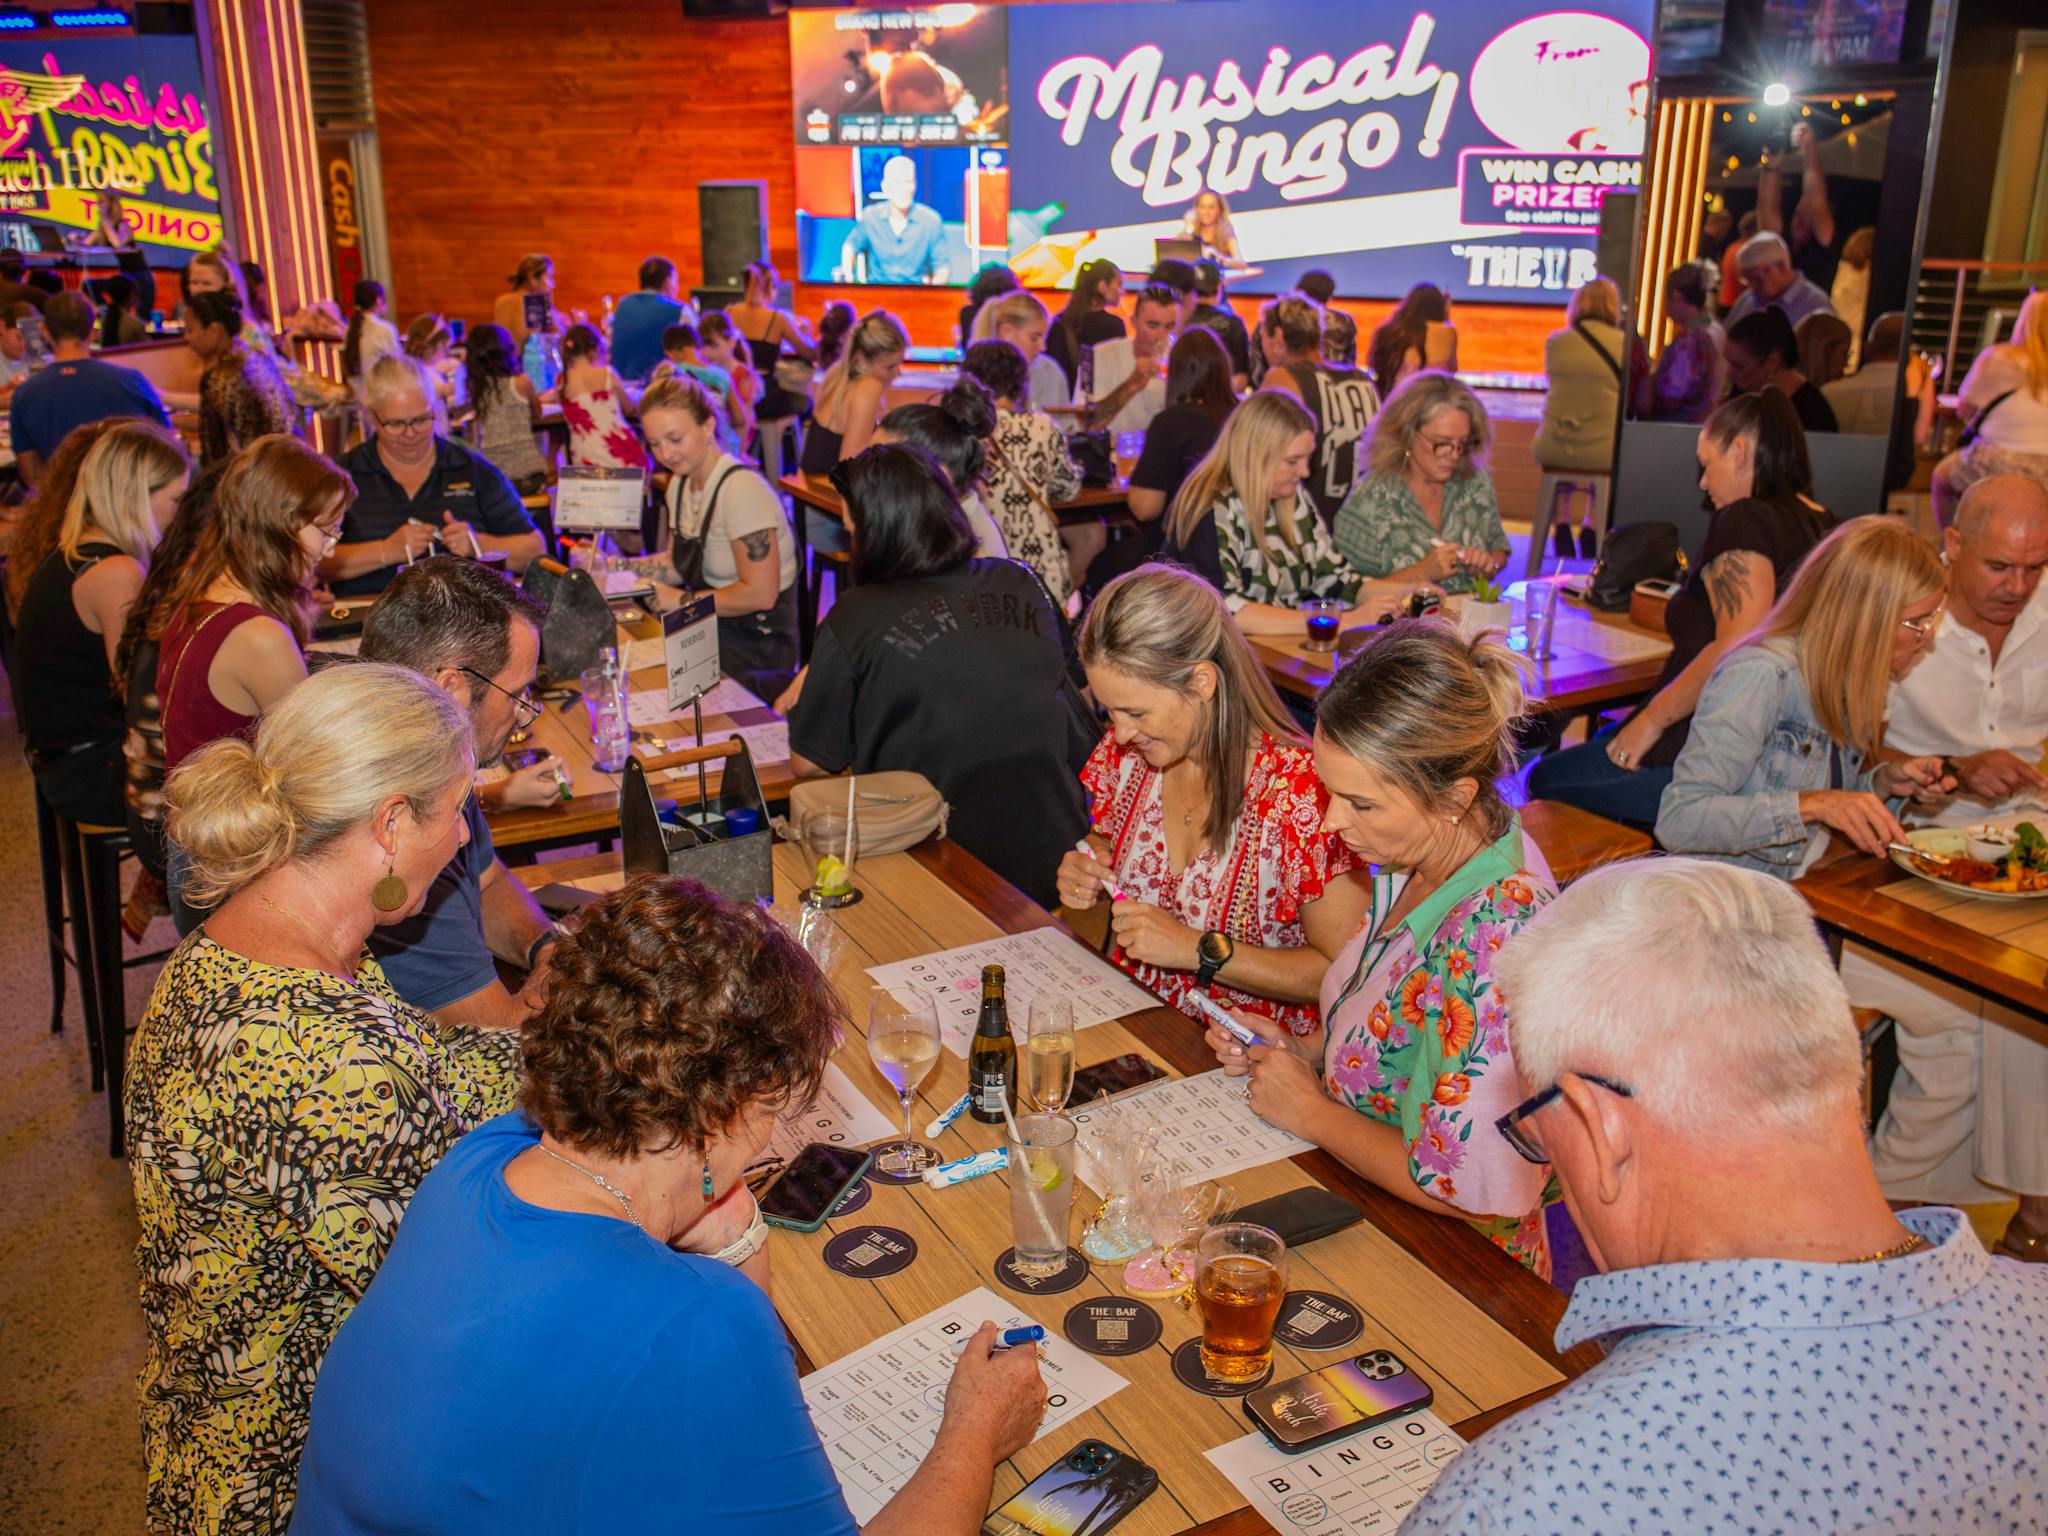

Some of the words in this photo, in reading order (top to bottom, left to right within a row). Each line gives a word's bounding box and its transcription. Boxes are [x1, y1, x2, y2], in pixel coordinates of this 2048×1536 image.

[1037, 12, 1438, 147] Musical
[1481, 159, 1549, 183] WIN
[1554, 160, 1643, 185] CASH
[329, 158, 360, 247] Cash
[959, 592, 1041, 638] YORK
[681, 630, 706, 649] RESERVED
[911, 964, 925, 972] O
[1076, 1115, 1091, 1123] O
[816, 1119, 832, 1128] G
[829, 1133, 845, 1142] O
[867, 1231, 886, 1244] THE
[884, 1240, 903, 1253] BAR
[1089, 1307, 1109, 1316] THE
[1115, 1307, 1136, 1316] BAR
[1304, 1297, 1325, 1310] THE
[1326, 1307, 1348, 1321] BAR
[942, 1322, 962, 1335] B
[1048, 1394, 1067, 1407] O
[1035, 1354, 1064, 1373] THEMES
[1279, 1398, 1317, 1426] Beach
[1268, 1478, 1291, 1493] B
[1308, 1464, 1322, 1477] I
[1337, 1448, 1361, 1465] N
[1372, 1436, 1394, 1450] G
[1405, 1422, 1425, 1436] O
[857, 1462, 870, 1471] The
[870, 1472, 885, 1483] Files
[1361, 1474, 1390, 1488] Entourage
[1330, 1490, 1353, 1501] Cheers
[1394, 1499, 1413, 1511] MASH
